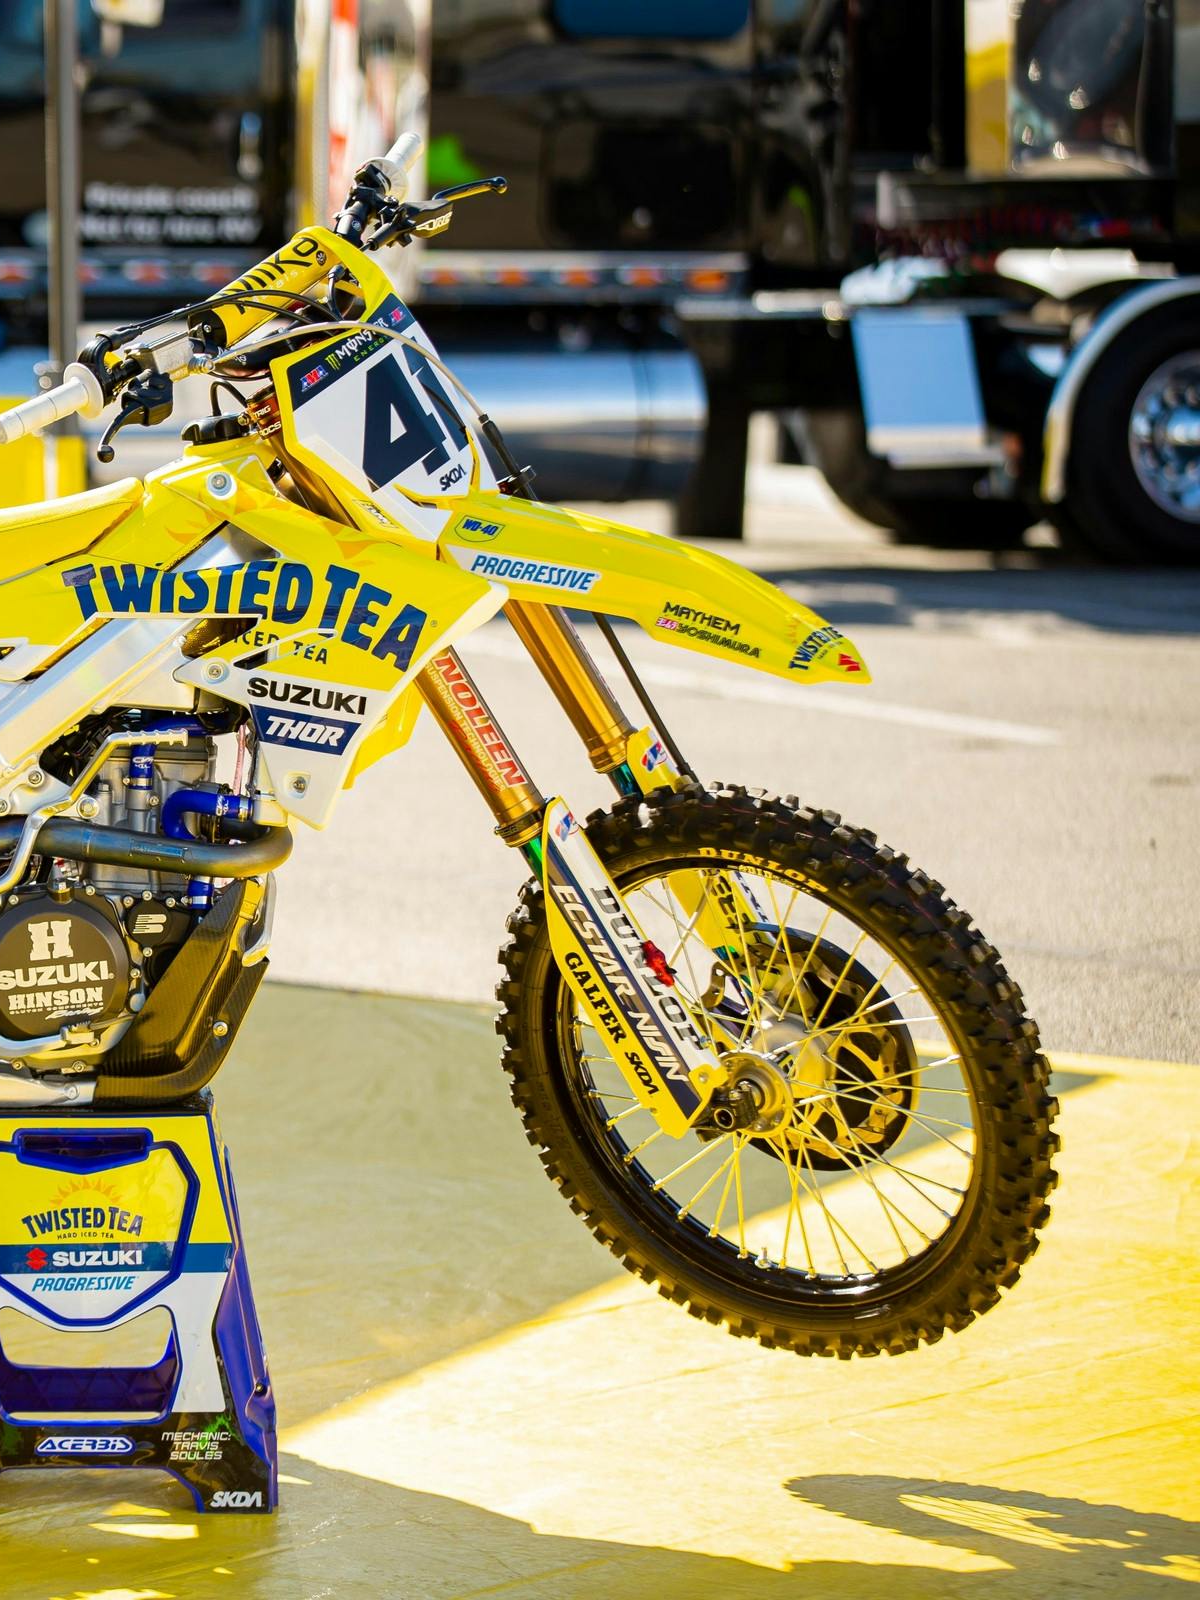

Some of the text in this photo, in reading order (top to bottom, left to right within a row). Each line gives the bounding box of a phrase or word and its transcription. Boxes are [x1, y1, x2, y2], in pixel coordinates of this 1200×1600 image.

[335, 317, 389, 360] MONSER
[353, 335, 388, 362] ENERG
[362, 335, 469, 488] 41
[462, 518, 499, 536] WD-40
[470, 554, 596, 591] PROGRESSIVE
[61, 558, 428, 673] TWISTED TEA
[663, 601, 740, 635] MAYHEM
[676, 623, 761, 658] YOSHIMURA
[247, 677, 367, 715] SUZUKI
[265, 715, 345, 747] THOR
[432, 652, 529, 788] NOLEEN
[697, 847, 828, 893] DUNLOP
[551, 885, 637, 1000] ECSTAR
[590, 885, 704, 1051] DUNLOP
[8, 986, 103, 1011] HINSON
[565, 952, 627, 1044] GALFER
[625, 1051, 659, 1095] SKDA
[22, 1206, 144, 1238] TWISTED TEA
[101, 1231, 115, 1240] TEA
[52, 1250, 143, 1268] SUZUKI
[31, 1275, 136, 1292] PROGRESSIVE
[38, 1437, 133, 1453] ACERBIS
[161, 1431, 231, 1441] MECHANIC:
[174, 1441, 220, 1451] TRAVIS
[169, 1451, 223, 1460] SOULES
[210, 1491, 263, 1508] SKDA
